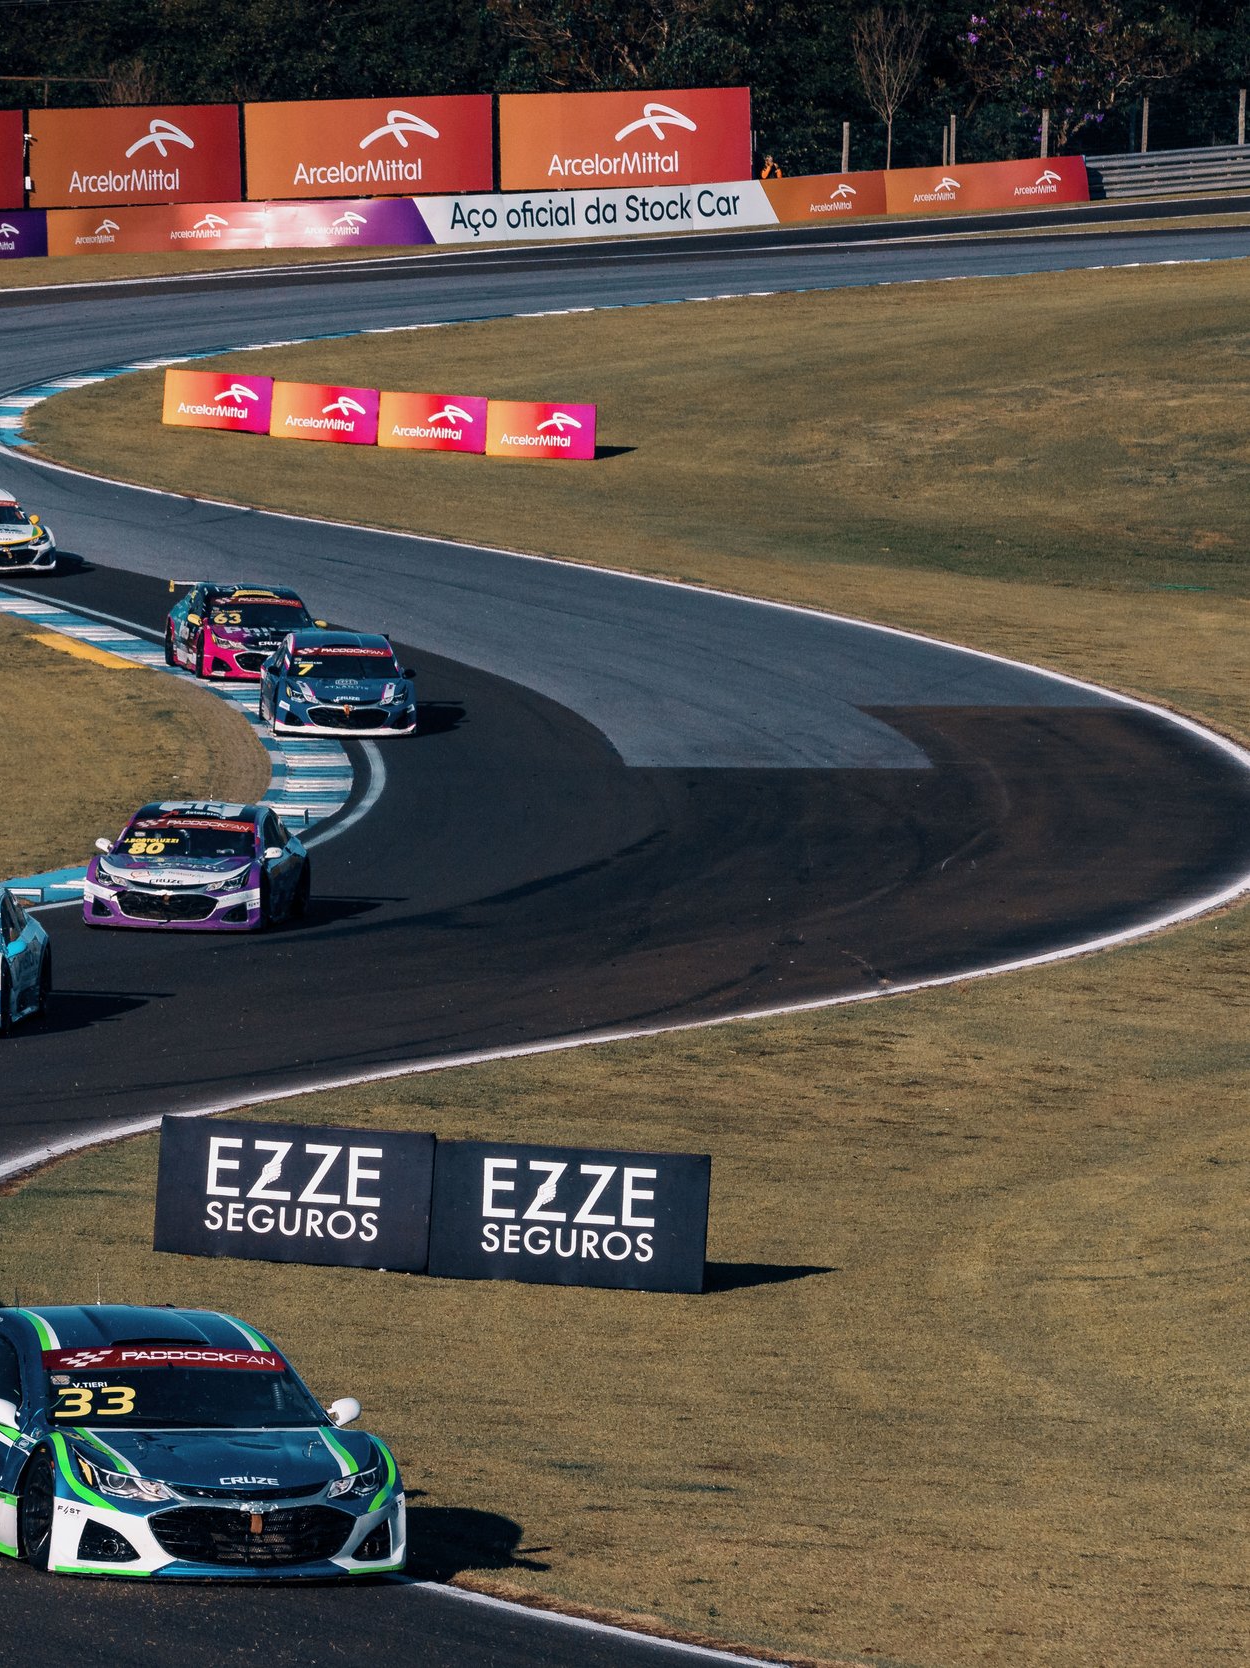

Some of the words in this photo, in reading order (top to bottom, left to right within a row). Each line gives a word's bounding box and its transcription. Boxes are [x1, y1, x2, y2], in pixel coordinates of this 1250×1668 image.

[293, 157, 423, 186] ArcelorMittal
[547, 150, 680, 177] ArcelorMittal
[68, 169, 180, 194] ArcelorMittal
[913, 191, 957, 203] ArcelorMittal
[1013, 184, 1058, 197] ArcelorMittal
[449, 200, 499, 237] Aço
[505, 197, 575, 229] oficial
[584, 195, 618, 225] da
[625, 193, 693, 222] Stock
[697, 190, 740, 219] Car
[809, 199, 853, 213] ArcelorMittal
[75, 233, 115, 246] ArcelorMittal
[170, 227, 222, 240] ArcelorMittal
[177, 401, 248, 420] ArcelorMittal
[285, 414, 355, 433] ArcelorMittal
[391, 424, 462, 442] ArcelorMittal
[500, 433, 571, 448] ArcelorMittal
[213, 613, 242, 624] 63
[321, 647, 384, 656] PADDOCKFAN
[298, 663, 314, 676] 7
[166, 819, 250, 831] PADDOCKFAN
[128, 842, 165, 855] 80
[205, 1136, 383, 1207] EZZE
[482, 1157, 657, 1228] EZZE
[204, 1200, 379, 1243] SEGUROS
[481, 1222, 654, 1263] SEGUROS
[121, 1350, 276, 1367] PADDOCKFAN
[72, 1381, 108, 1389] V.TIERI
[54, 1386, 137, 1418] 33
[219, 1476, 280, 1486] CRUZE
